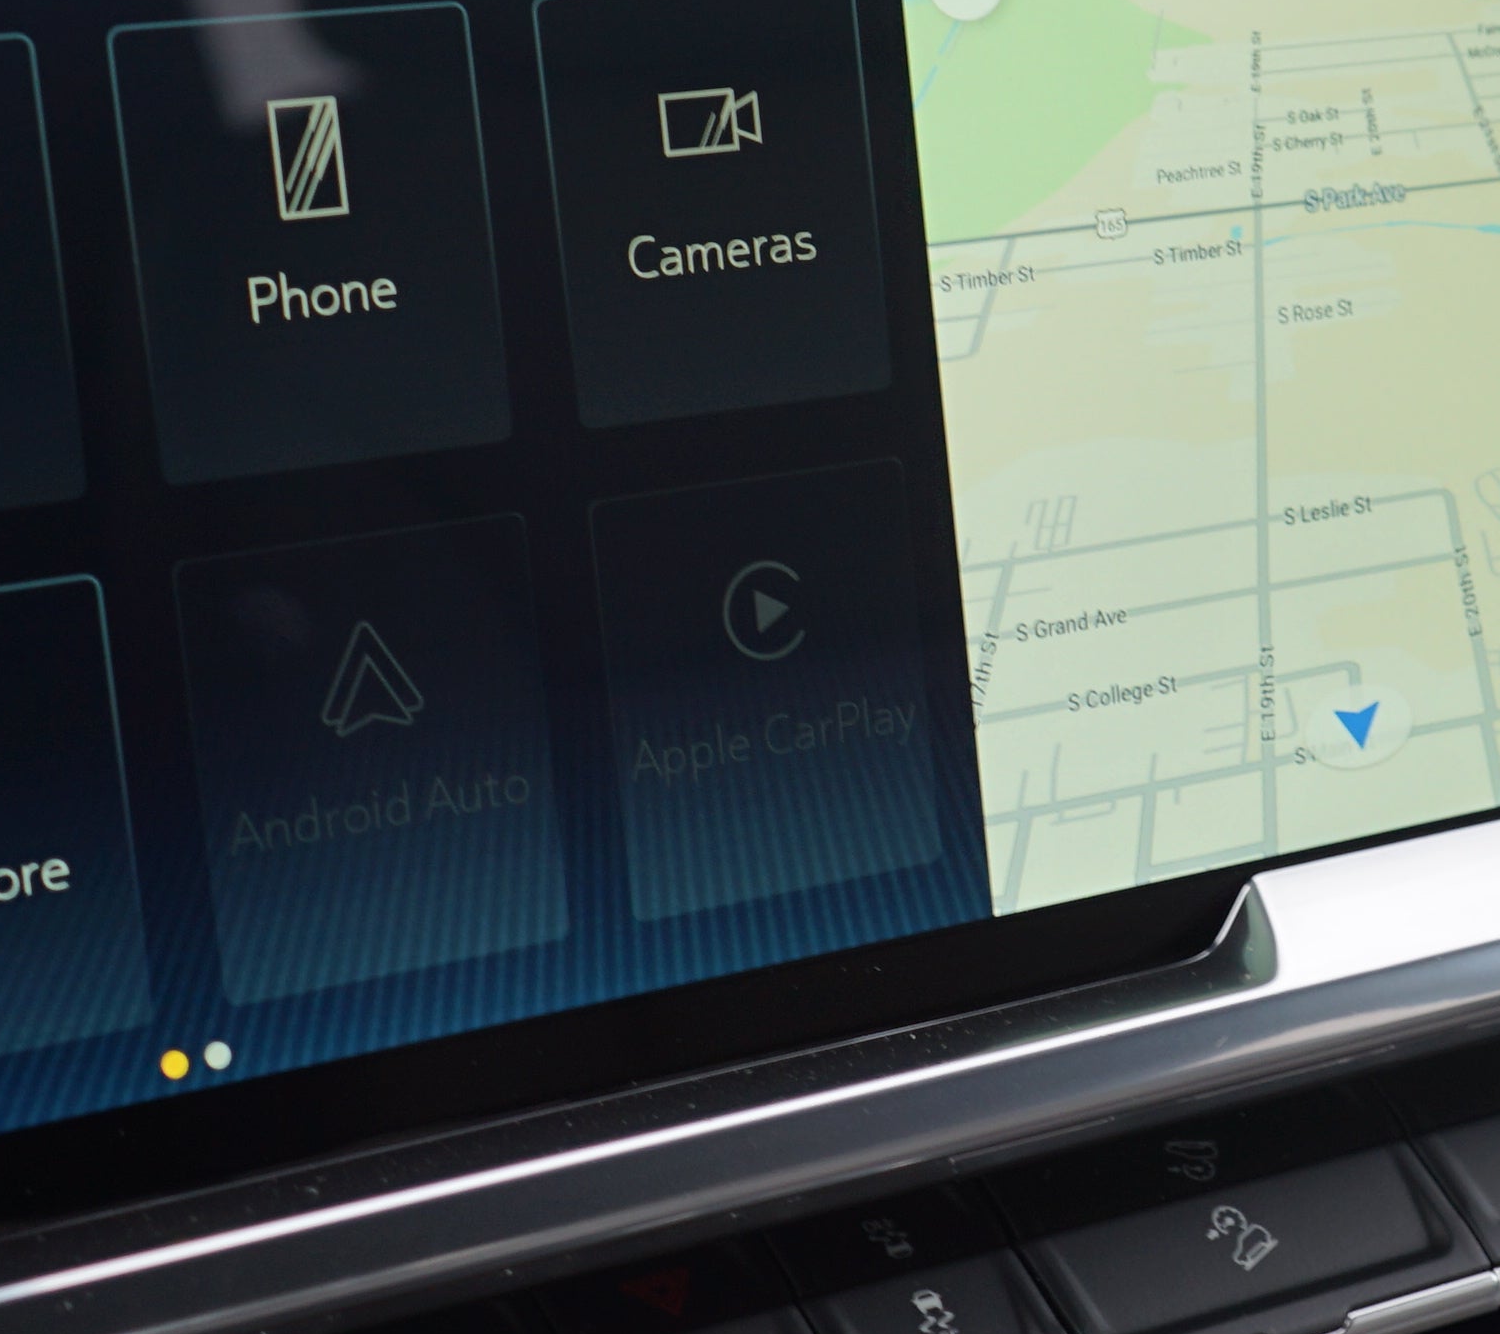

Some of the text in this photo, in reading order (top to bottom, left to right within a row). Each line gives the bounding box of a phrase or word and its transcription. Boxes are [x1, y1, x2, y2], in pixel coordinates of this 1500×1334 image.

[1300, 107, 1323, 122] Oak
[1326, 106, 1339, 120] St
[1252, 124, 1267, 141] St
[1285, 133, 1326, 153] Cherry
[1330, 131, 1343, 146] St
[1156, 160, 1242, 185] Peachtree St
[1251, 143, 1264, 184] 19th
[1304, 181, 1407, 212] S Park Ave
[1100, 217, 1123, 234] 165
[625, 224, 818, 280] Cameras
[1153, 239, 1242, 266] S Timber St
[940, 264, 1035, 293] S Timber St
[246, 274, 399, 324] Phone
[1277, 298, 1353, 324] S Rose St
[1284, 495, 1372, 525] S Leslie St
[1454, 545, 1469, 567] St
[1460, 569, 1480, 620] 20th
[1015, 608, 1128, 643] S Grand Ave
[980, 632, 1000, 656] St
[1067, 676, 1178, 712] S College St
[1259, 644, 1276, 742] E 19th St
[632, 697, 918, 790] Apple CarPlay
[1294, 746, 1307, 765] S
[228, 771, 531, 858] Android Auto
